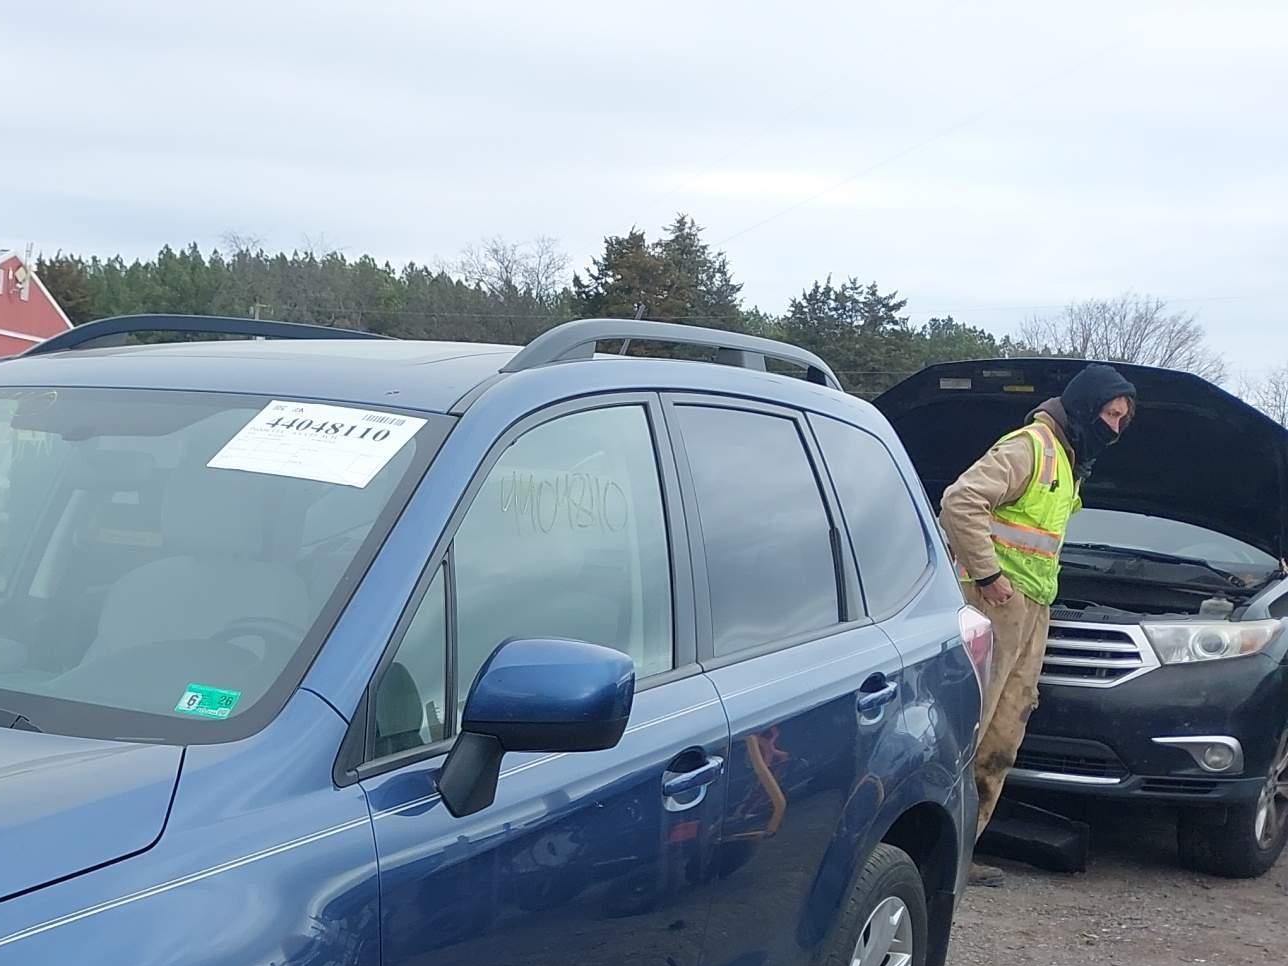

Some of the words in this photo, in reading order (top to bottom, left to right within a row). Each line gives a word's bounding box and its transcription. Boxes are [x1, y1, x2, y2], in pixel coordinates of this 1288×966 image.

[265, 416, 392, 443] 44048110
[186, 694, 199, 707] 6
[217, 695, 234, 706] 26
